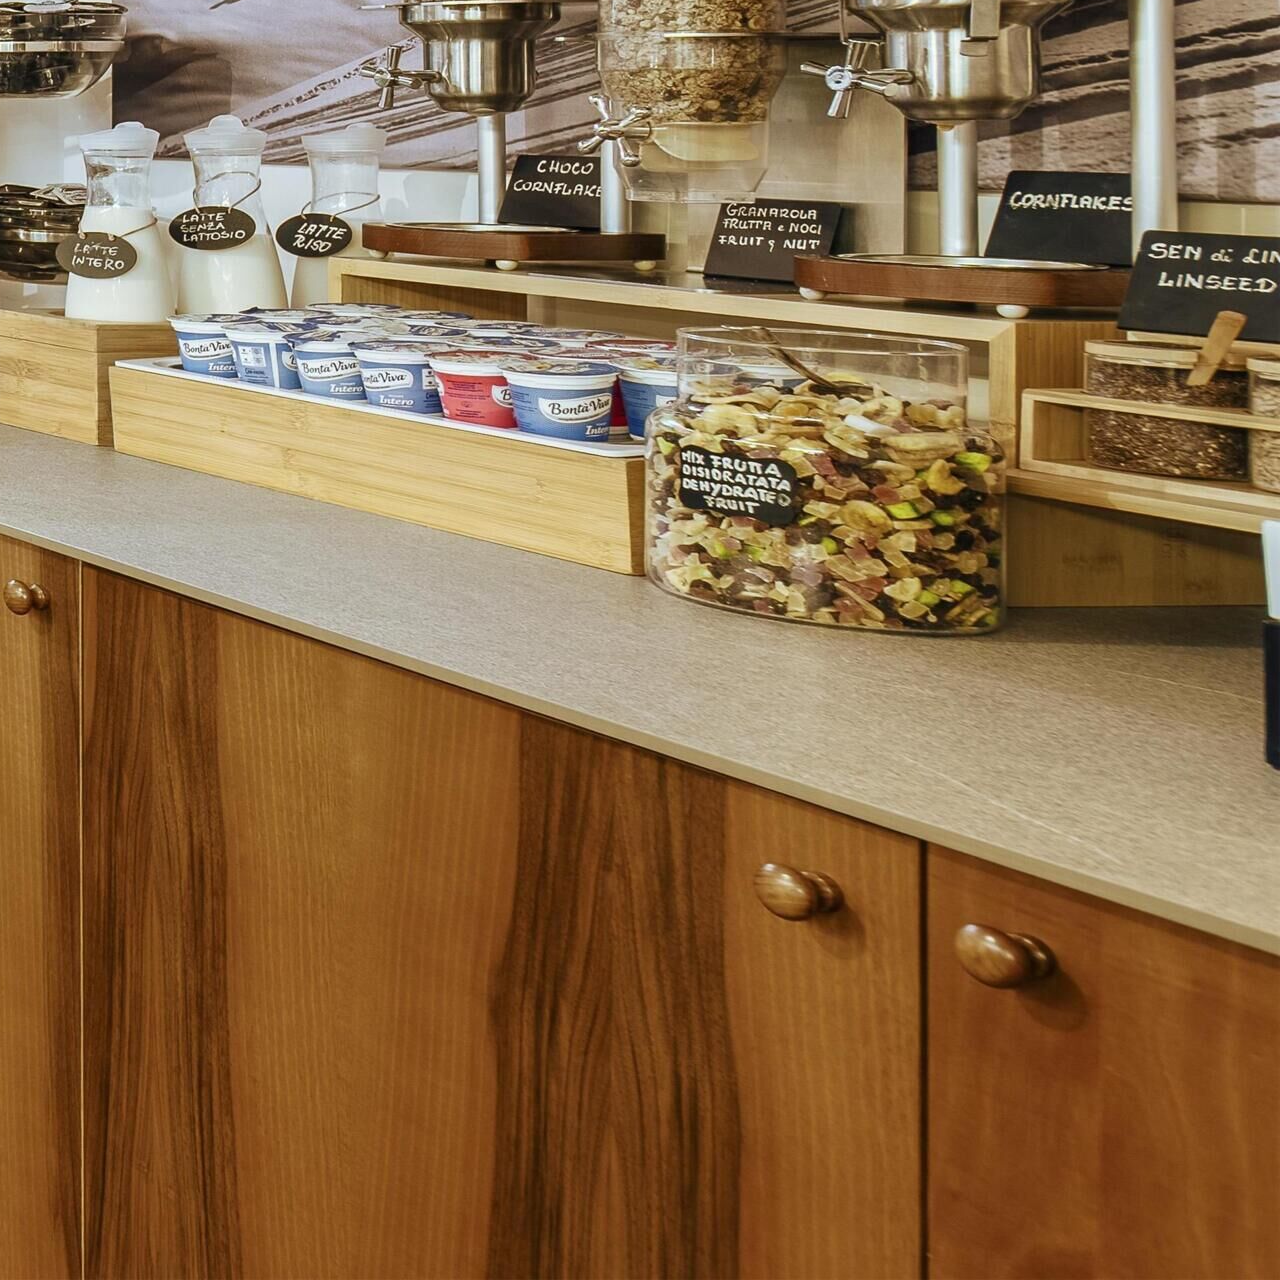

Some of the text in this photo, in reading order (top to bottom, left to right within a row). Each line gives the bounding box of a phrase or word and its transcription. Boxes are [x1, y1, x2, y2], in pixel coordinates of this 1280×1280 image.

[537, 160, 594, 174] CHOCO
[513, 180, 602, 197] CORNFLAKE
[1009, 191, 1133, 212] CORNFLAKES
[182, 212, 226, 224] LATTE
[726, 203, 817, 220] GRANAROLA
[180, 221, 225, 232] SENZA
[297, 222, 347, 240] LATTE
[723, 218, 772, 230] FRUTTA
[788, 222, 822, 235] NOCI
[183, 229, 246, 242] LATTOSIO
[293, 234, 333, 252] RISO
[718, 235, 765, 246] FRUIT
[783, 239, 820, 250] NUT
[73, 241, 119, 256] LATTE
[1242, 248, 1280, 264] LIN
[71, 255, 124, 271] INTERO
[1157, 271, 1277, 294] LINSEED
[330, 361, 359, 372] Viva
[378, 372, 407, 383] Viva
[330, 384, 363, 393] Intero
[380, 395, 414, 406] Intero
[548, 402, 590, 416] Bontà
[709, 455, 782, 478] FRUTTA
[703, 495, 760, 514] FRUIT
